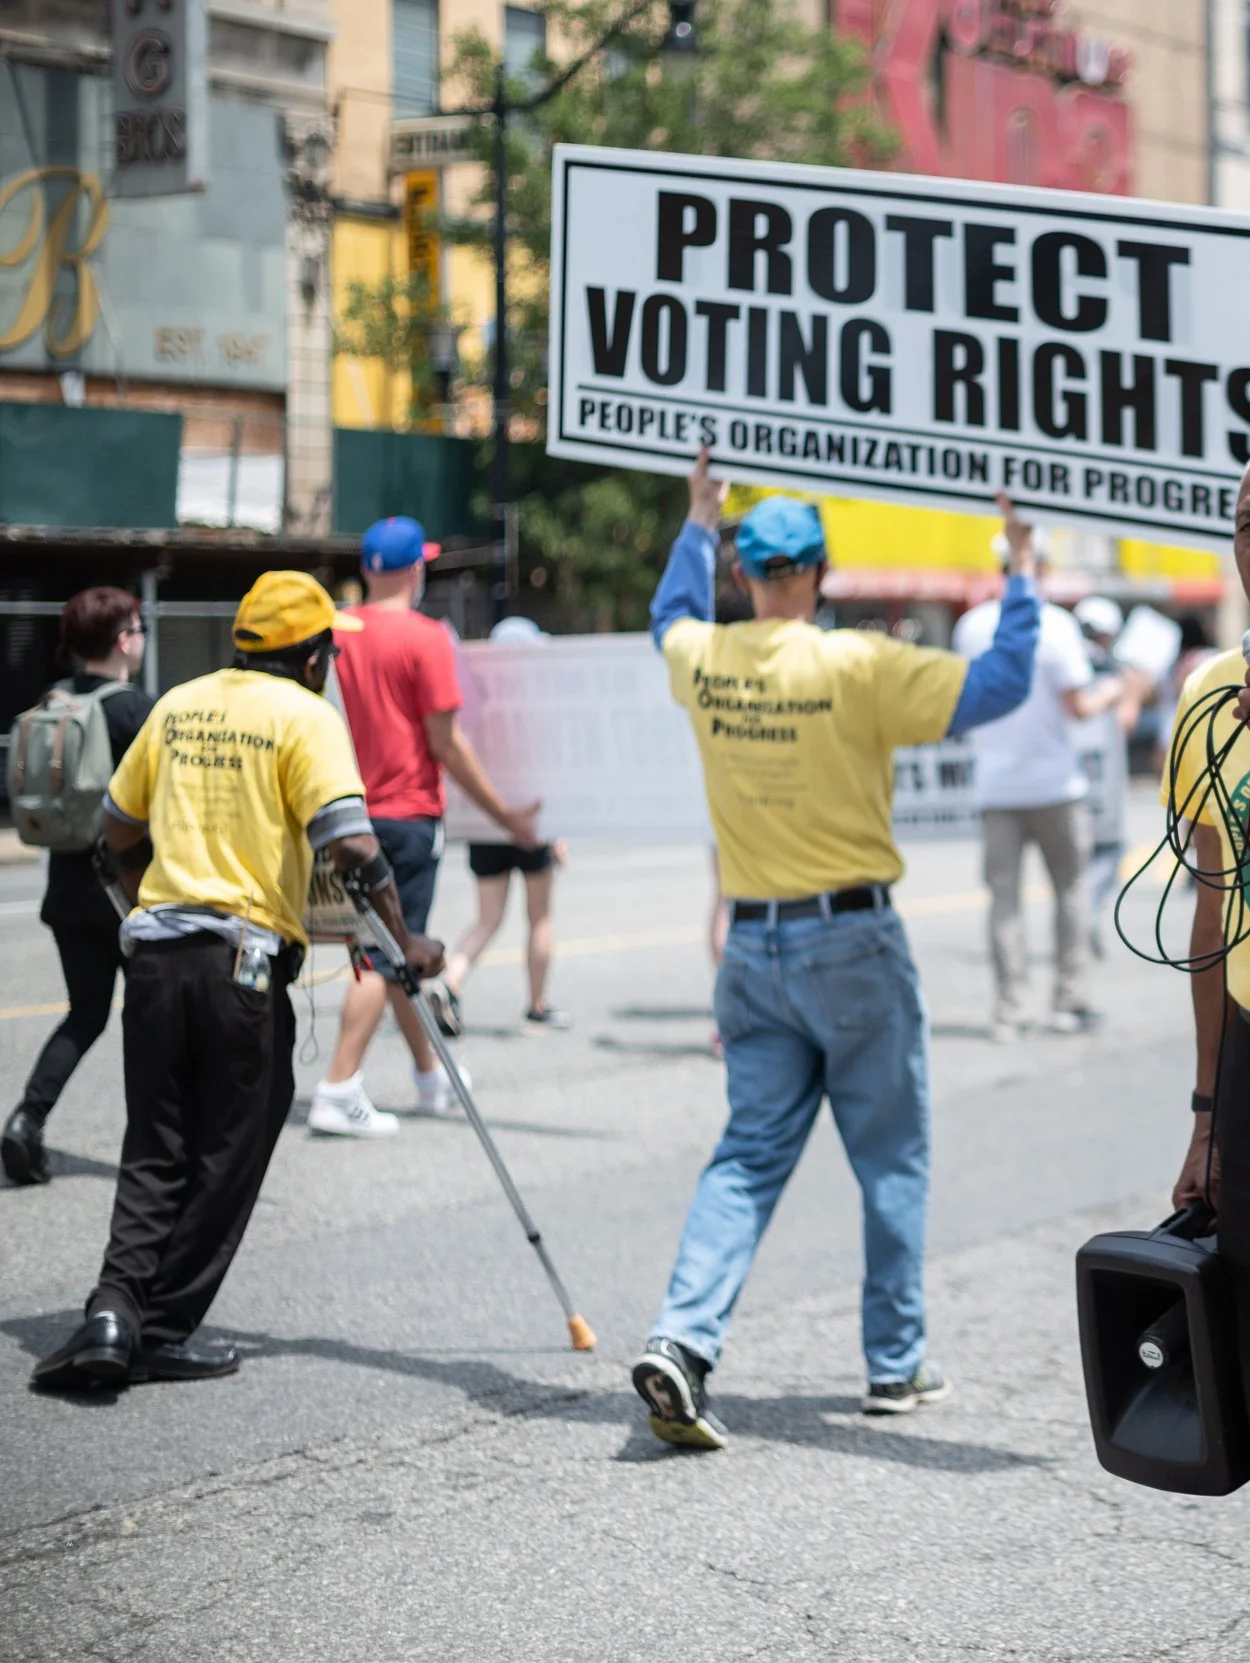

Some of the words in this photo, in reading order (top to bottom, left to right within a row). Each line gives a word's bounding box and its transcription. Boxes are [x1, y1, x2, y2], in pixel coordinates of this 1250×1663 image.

[657, 190, 1190, 343] PROTECT
[585, 285, 892, 415] VOTING
[579, 397, 717, 447] PEOPLE'S
[731, 420, 989, 483] ORGANIZATION
[1003, 456, 1071, 496] FOR
